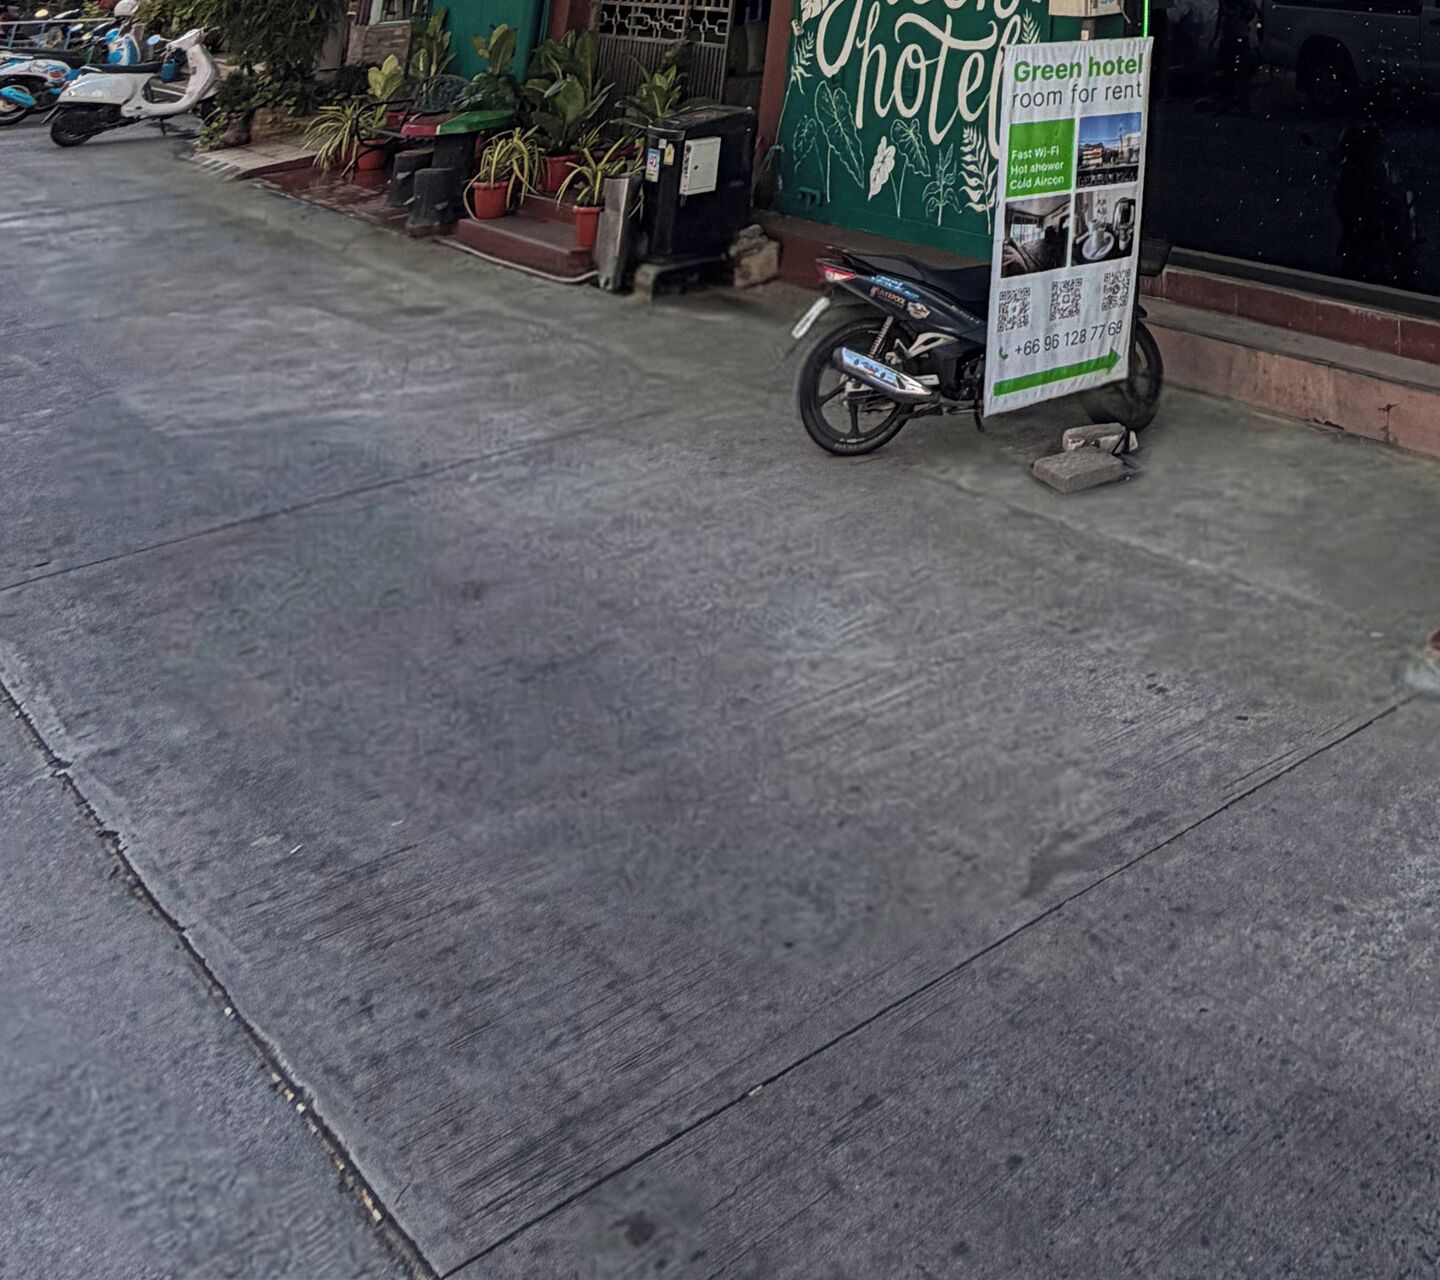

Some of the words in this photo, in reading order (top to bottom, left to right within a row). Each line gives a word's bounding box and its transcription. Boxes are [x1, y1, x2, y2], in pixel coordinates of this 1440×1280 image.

[856, 1, 1021, 160] hotel
[1013, 60, 1083, 83] Green
[1087, 52, 1143, 78] hotel
[1011, 89, 1063, 109] room
[1070, 82, 1098, 104] for
[1104, 80, 1143, 101] rent
[1011, 149, 1033, 161] Fast
[1034, 145, 1059, 158] Wi-Fi
[1009, 177, 1032, 190] Cold
[1033, 175, 1064, 188] Aircon
[1010, 164, 1028, 176] Hot
[1030, 161, 1064, 173] shower
[1015, 339, 1041, 356] +66
[1044, 334, 1059, 351] 96
[1064, 328, 1087, 347] 128
[1090, 324, 1105, 341] 77
[1107, 319, 1122, 336] 69
